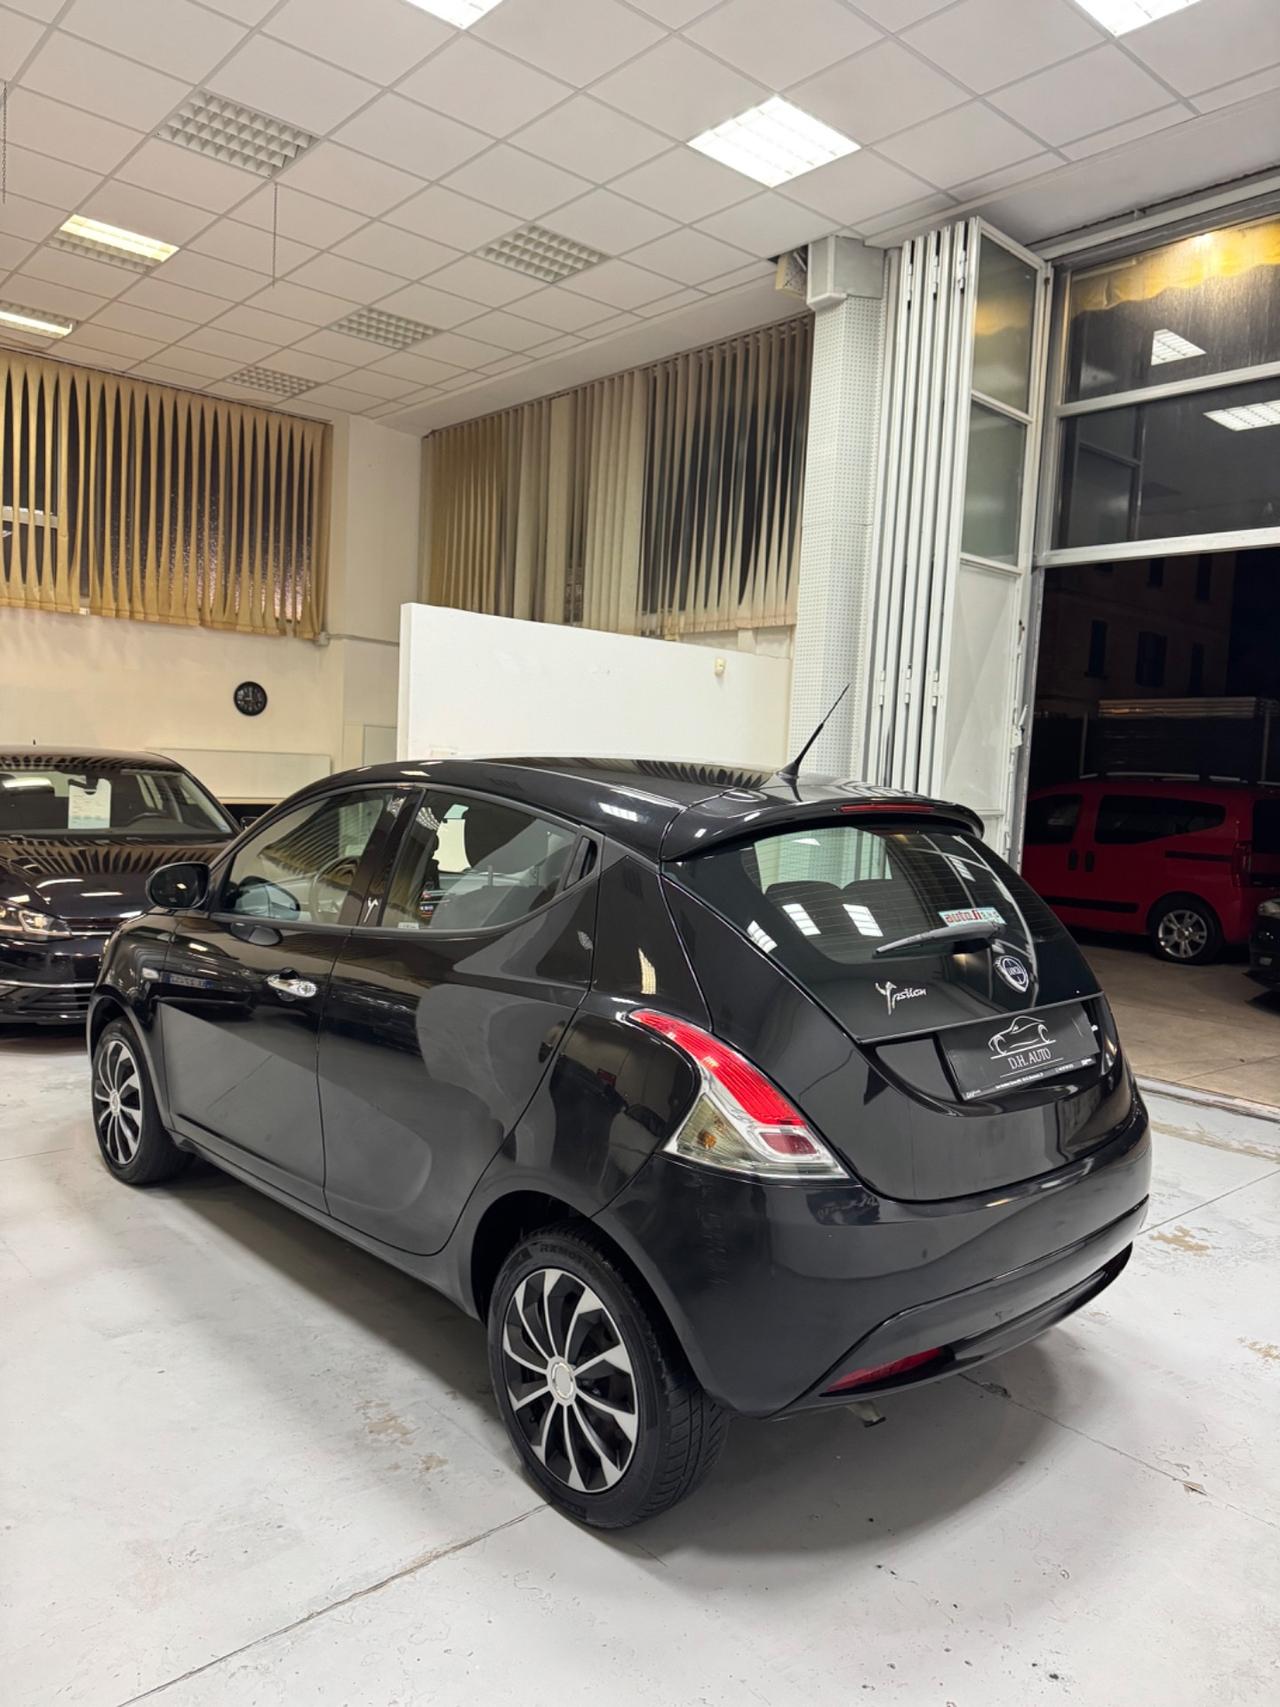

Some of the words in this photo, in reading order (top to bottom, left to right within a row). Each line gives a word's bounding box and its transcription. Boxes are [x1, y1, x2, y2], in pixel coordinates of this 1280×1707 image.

[875, 981, 927, 1015] Ypsilon
[1008, 1055, 1029, 1069] D.H.
[1029, 1048, 1051, 1064] AUTO
